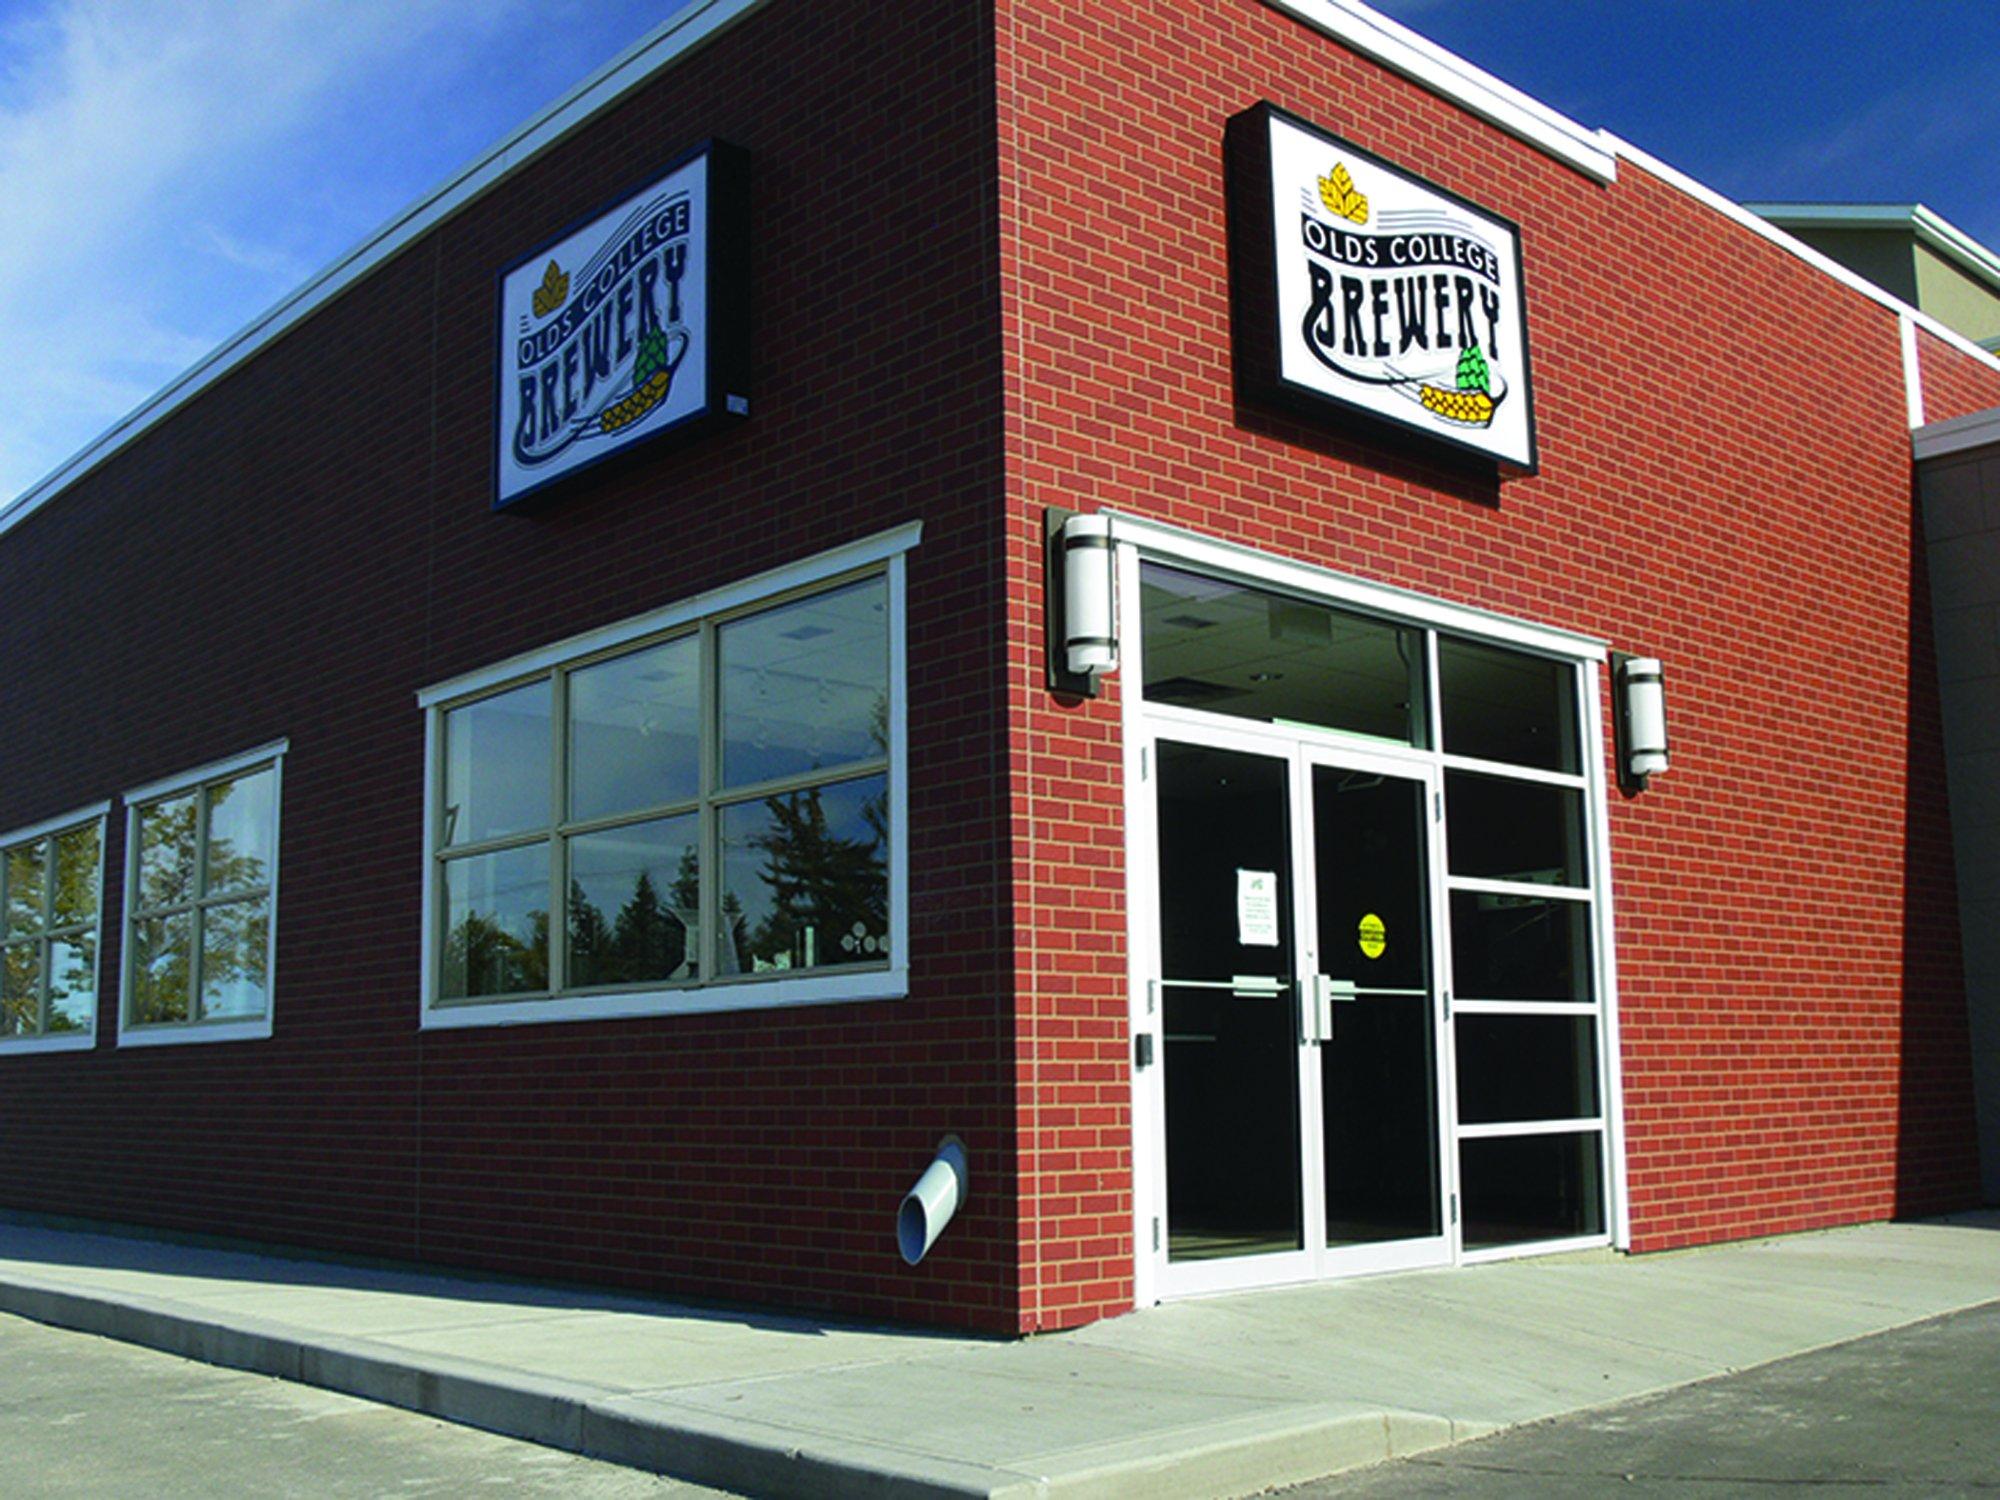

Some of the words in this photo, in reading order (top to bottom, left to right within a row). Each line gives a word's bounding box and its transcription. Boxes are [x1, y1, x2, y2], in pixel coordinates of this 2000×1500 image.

[520, 310, 572, 365] OLDS
[583, 204, 686, 313] COLLEGE
[1303, 258, 1500, 361] BREWERY
[1304, 221, 1378, 265] OLDS
[1389, 237, 1497, 280] COLLEGE
[514, 243, 687, 449] BREWERY
